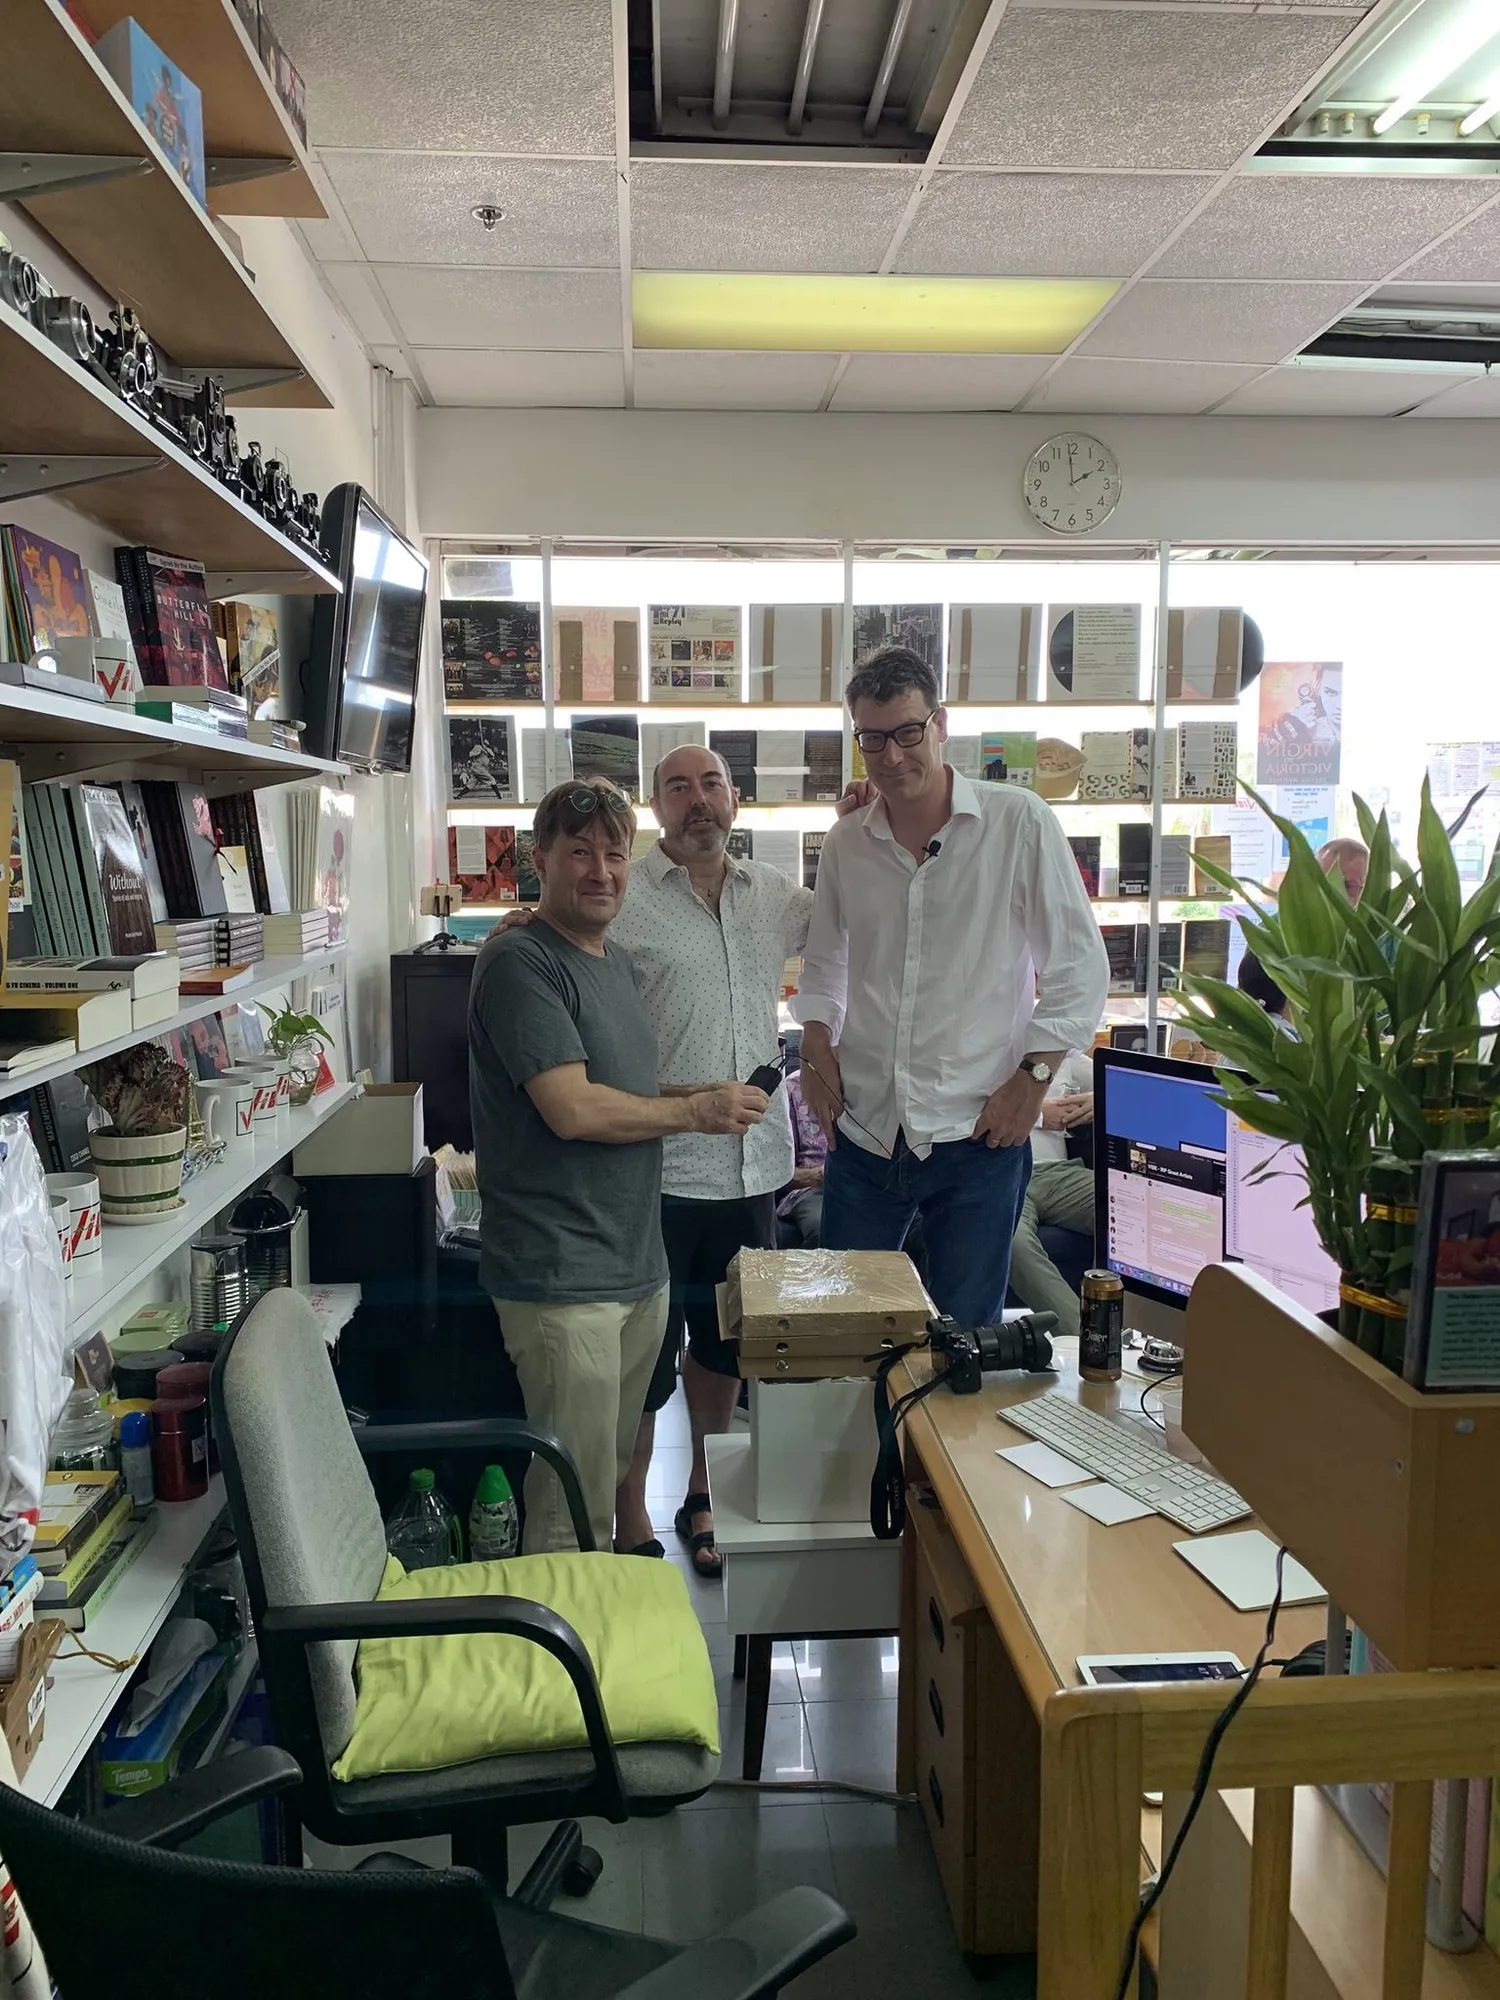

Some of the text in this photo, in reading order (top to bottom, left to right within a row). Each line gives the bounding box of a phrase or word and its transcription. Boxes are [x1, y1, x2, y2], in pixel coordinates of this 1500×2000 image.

[1051, 447, 1061, 459] 11
[1067, 442, 1078, 455] 12
[1088, 447, 1092, 459] 1
[1038, 460, 1050, 473] 10
[1097, 459, 1105, 471] 2
[1033, 478, 1042, 491] 9
[1103, 478, 1111, 490] 3
[1040, 496, 1048, 508] 8
[1097, 495, 1105, 507] 4
[1052, 509, 1060, 521] 7
[1068, 513, 1076, 526] 6
[1085, 509, 1094, 521] 5
[156, 594, 208, 612] BUTTERFLY
[174, 609, 194, 622] HILL
[660, 617, 682, 627] Replay
[109, 871, 141, 891] Without
[111, 1767, 149, 1784] Tempo
